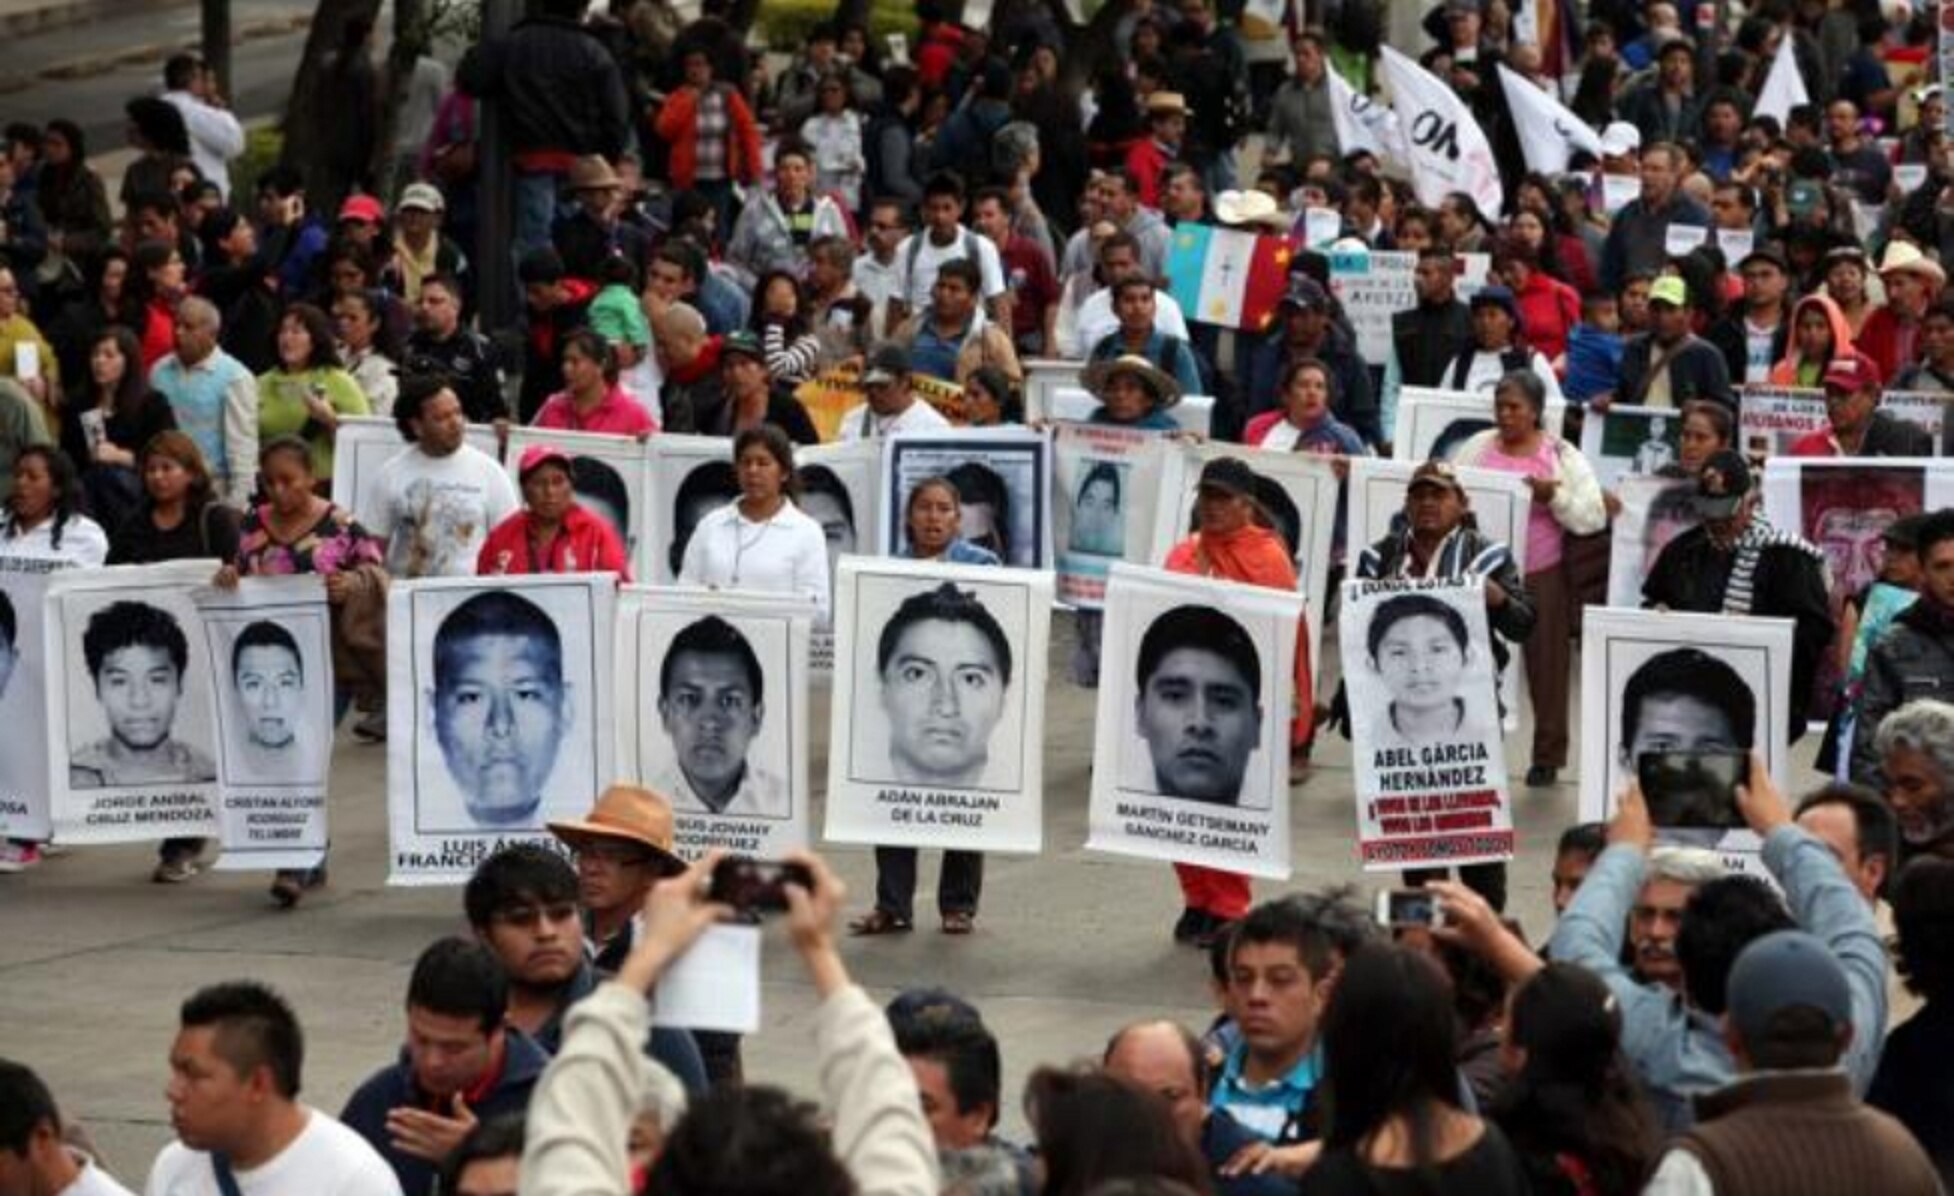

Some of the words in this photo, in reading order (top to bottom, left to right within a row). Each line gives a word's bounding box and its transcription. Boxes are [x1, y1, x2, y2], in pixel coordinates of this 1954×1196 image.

[1374, 748, 1417, 768] ABEL
[93, 795, 146, 810] JORGE
[925, 792, 999, 809] ABRAJAN
[86, 811, 131, 826] CRUZ
[134, 807, 214, 823] MENDOZA
[891, 808, 912, 822] DE
[916, 811, 937, 824] LA
[940, 812, 982, 826] CRUZ
[443, 837, 488, 854] LUIS
